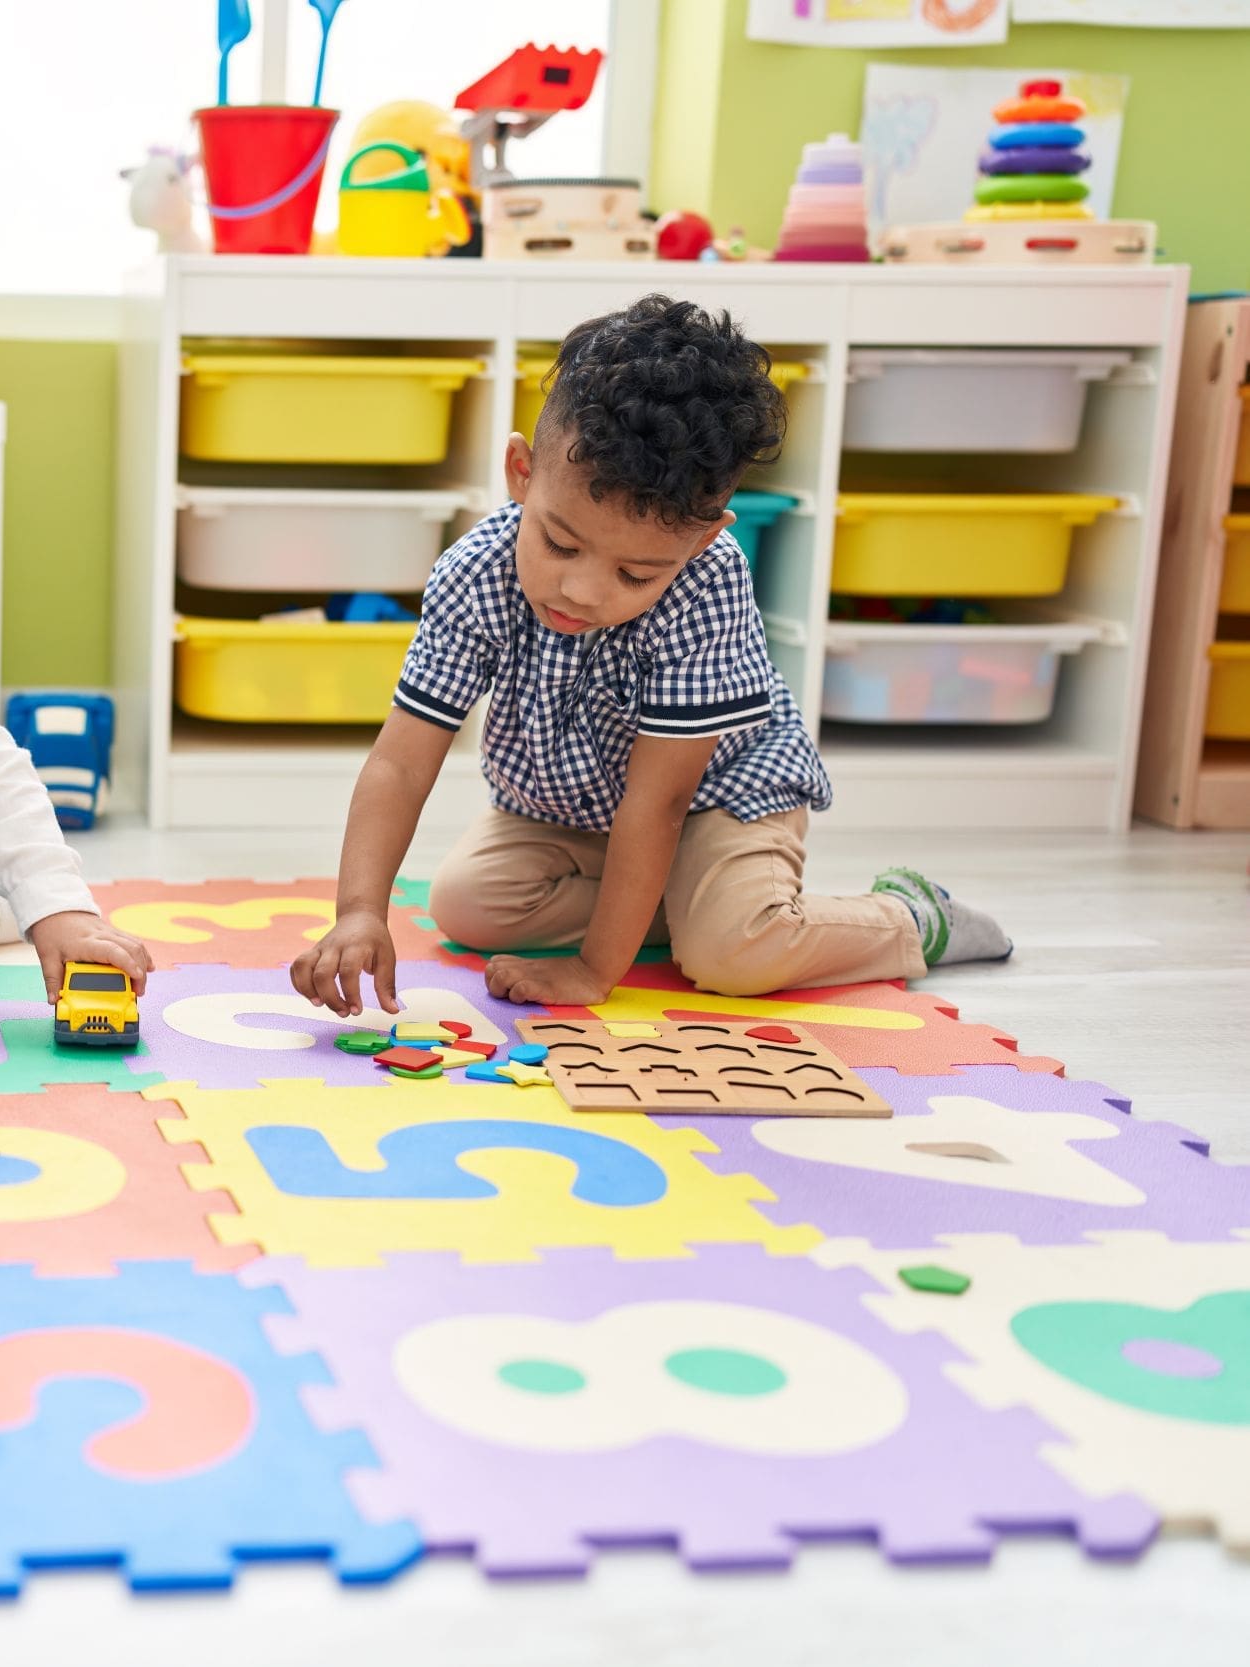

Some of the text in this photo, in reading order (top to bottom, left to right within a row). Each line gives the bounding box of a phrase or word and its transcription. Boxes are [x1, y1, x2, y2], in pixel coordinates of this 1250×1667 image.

[162, 988, 508, 1050] 2
[244, 1119, 669, 1208] 5
[751, 1095, 1147, 1207] 4
[391, 1300, 911, 1457] 8
